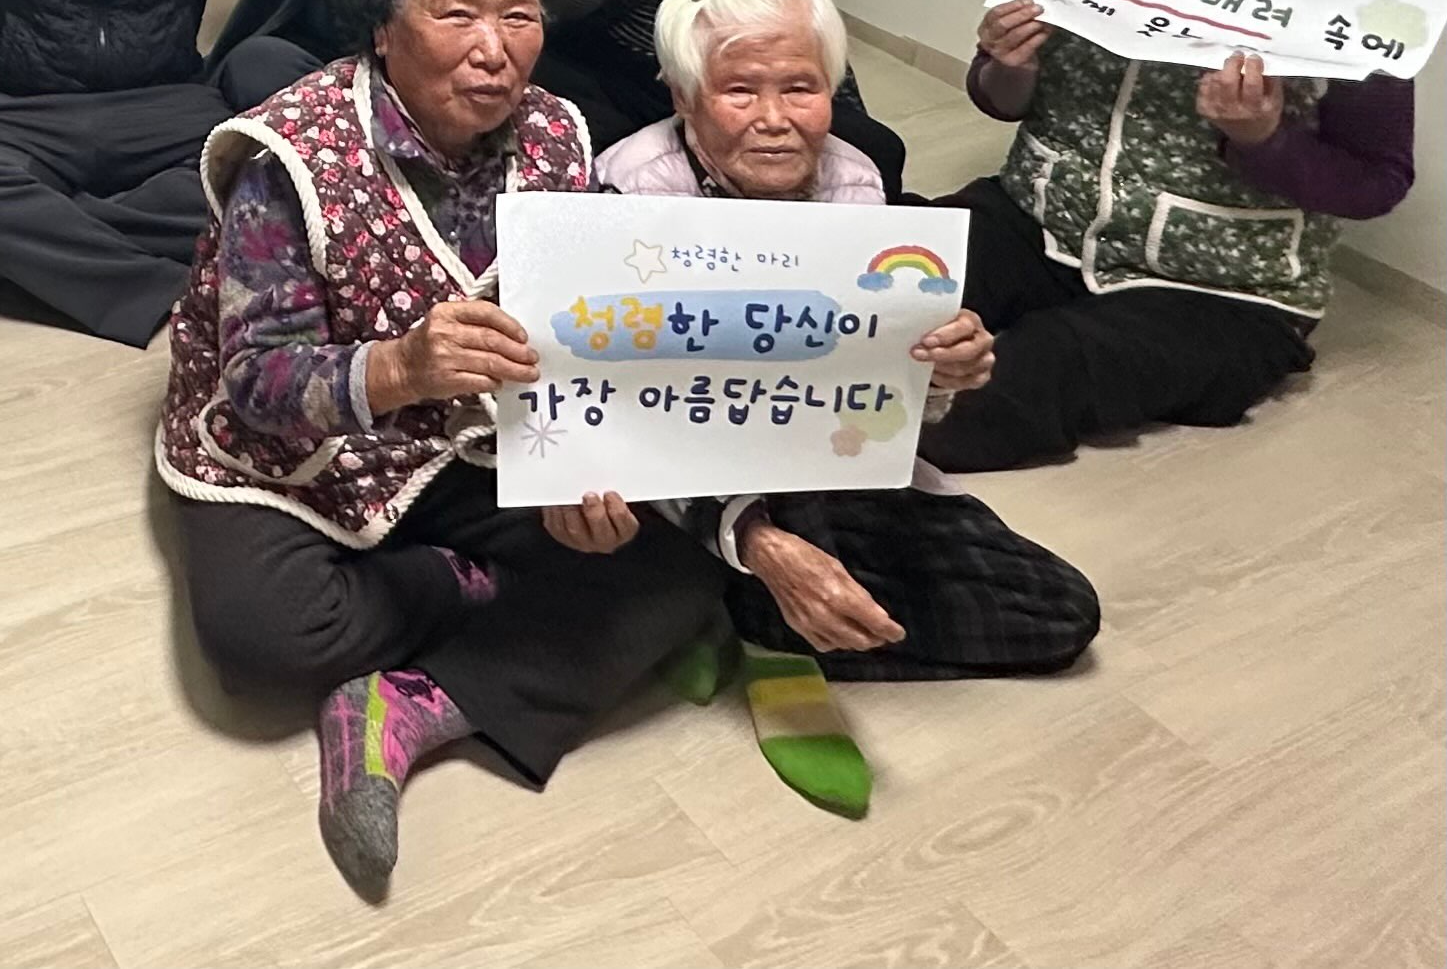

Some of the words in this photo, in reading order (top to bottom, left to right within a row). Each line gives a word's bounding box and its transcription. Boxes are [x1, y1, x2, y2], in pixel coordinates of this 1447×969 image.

[1322, 14, 1405, 61] 속에
[756, 253, 799, 269] 마리
[570, 295, 719, 352] 청렴한
[745, 302, 878, 353] 당신이
[518, 377, 616, 427] 가장
[639, 374, 894, 425] 아름답습니다
